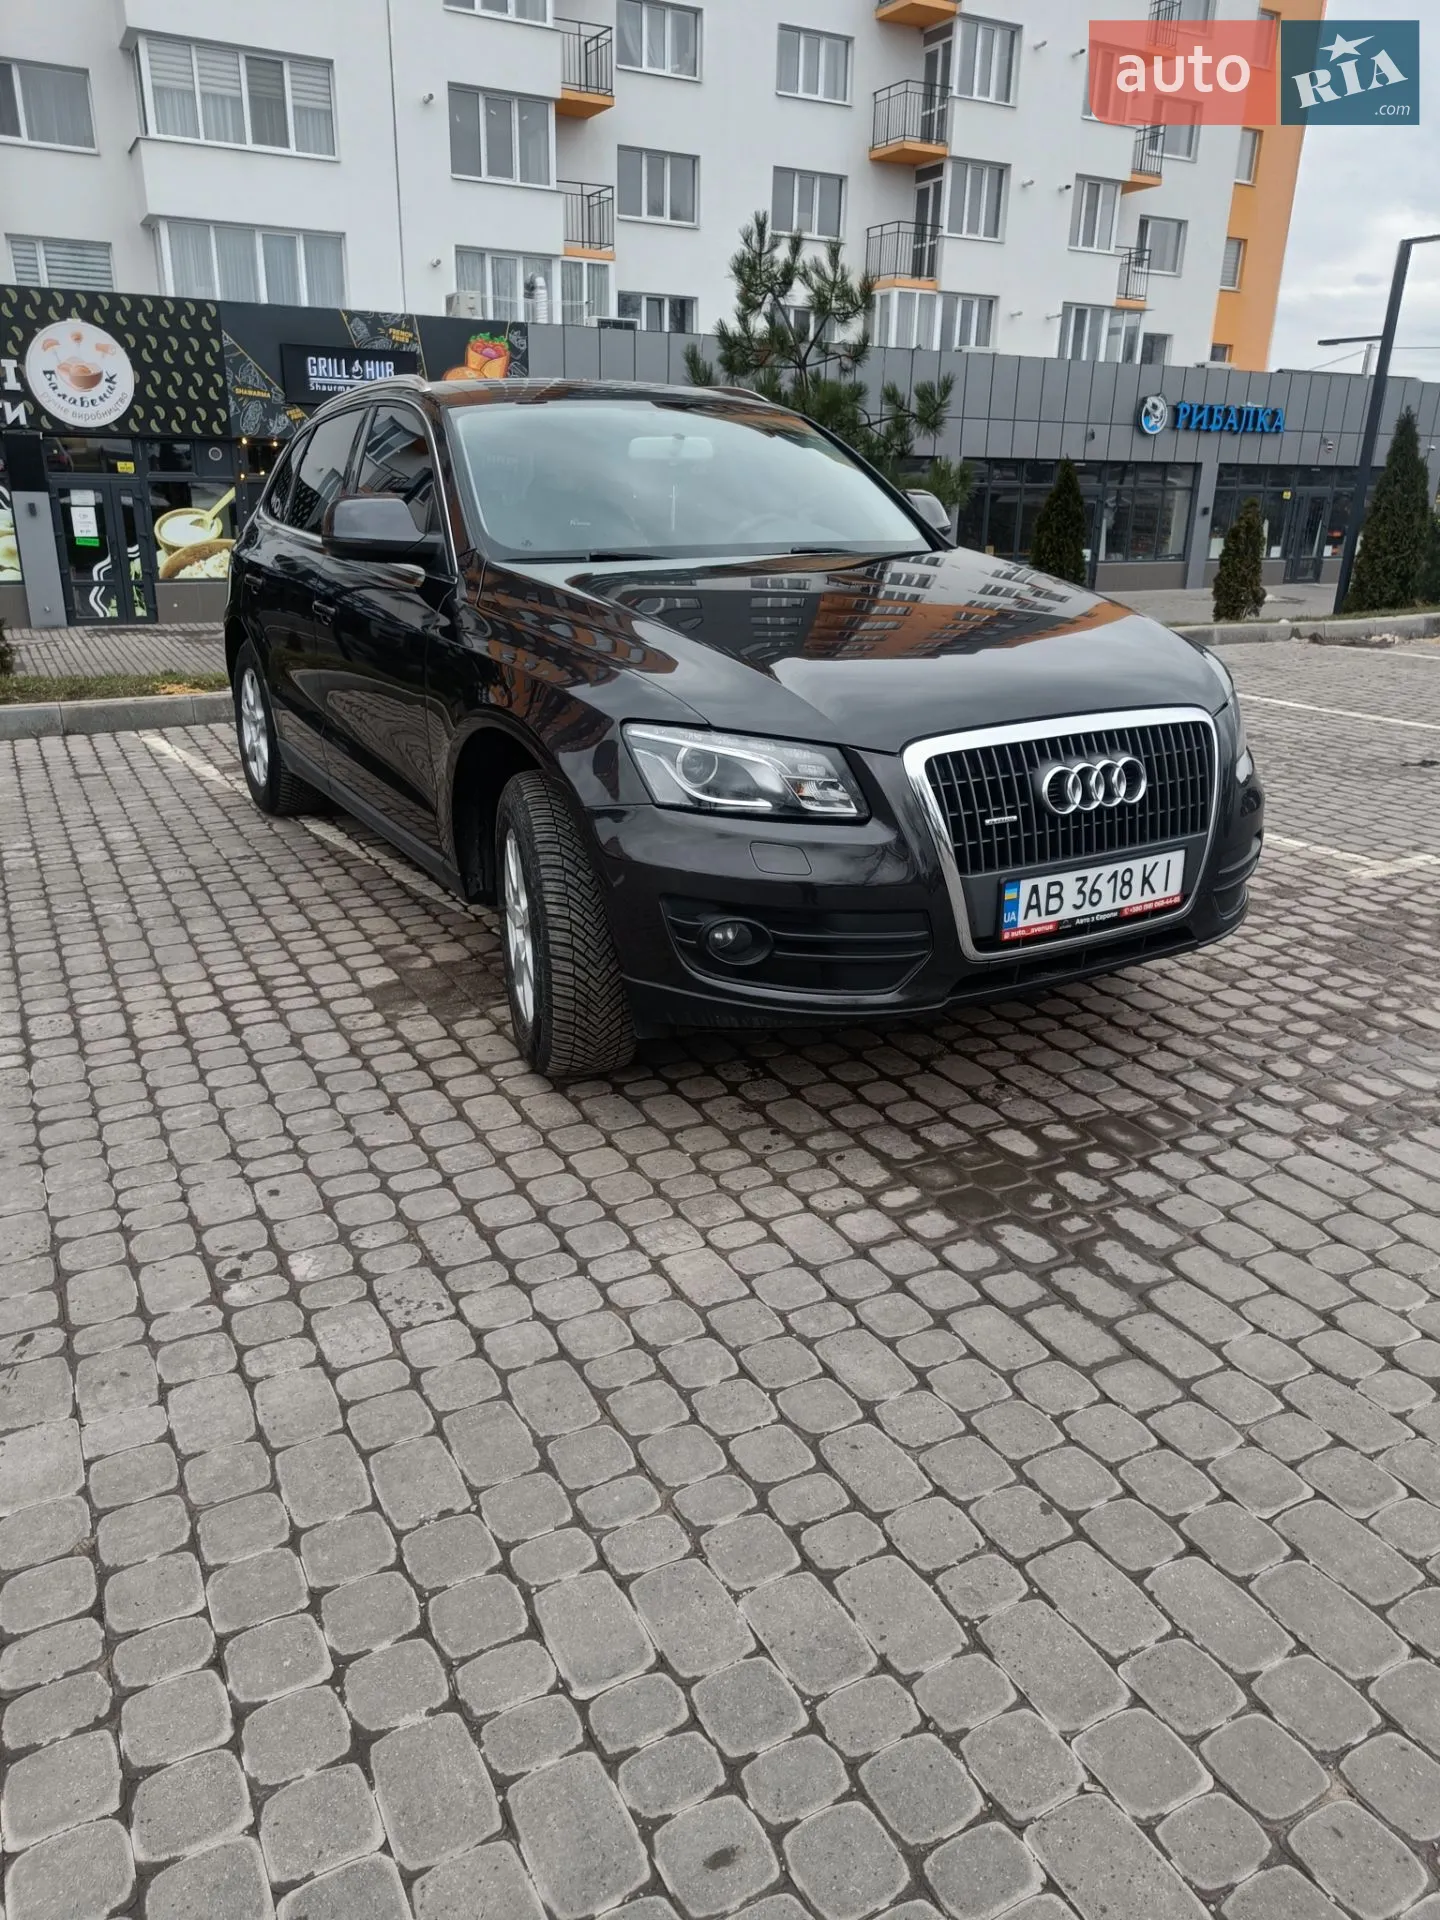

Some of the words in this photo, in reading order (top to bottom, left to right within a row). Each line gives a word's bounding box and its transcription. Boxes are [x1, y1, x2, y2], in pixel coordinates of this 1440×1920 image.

[307, 356, 350, 379] GRILL
[365, 359, 395, 380] HUB
[1176, 401, 1285, 433] РИБАЛКА
[1023, 880, 1064, 921] AB
[1071, 867, 1134, 911] 3618
[1140, 859, 1171, 897] KI
[1003, 911, 1017, 923] UA
